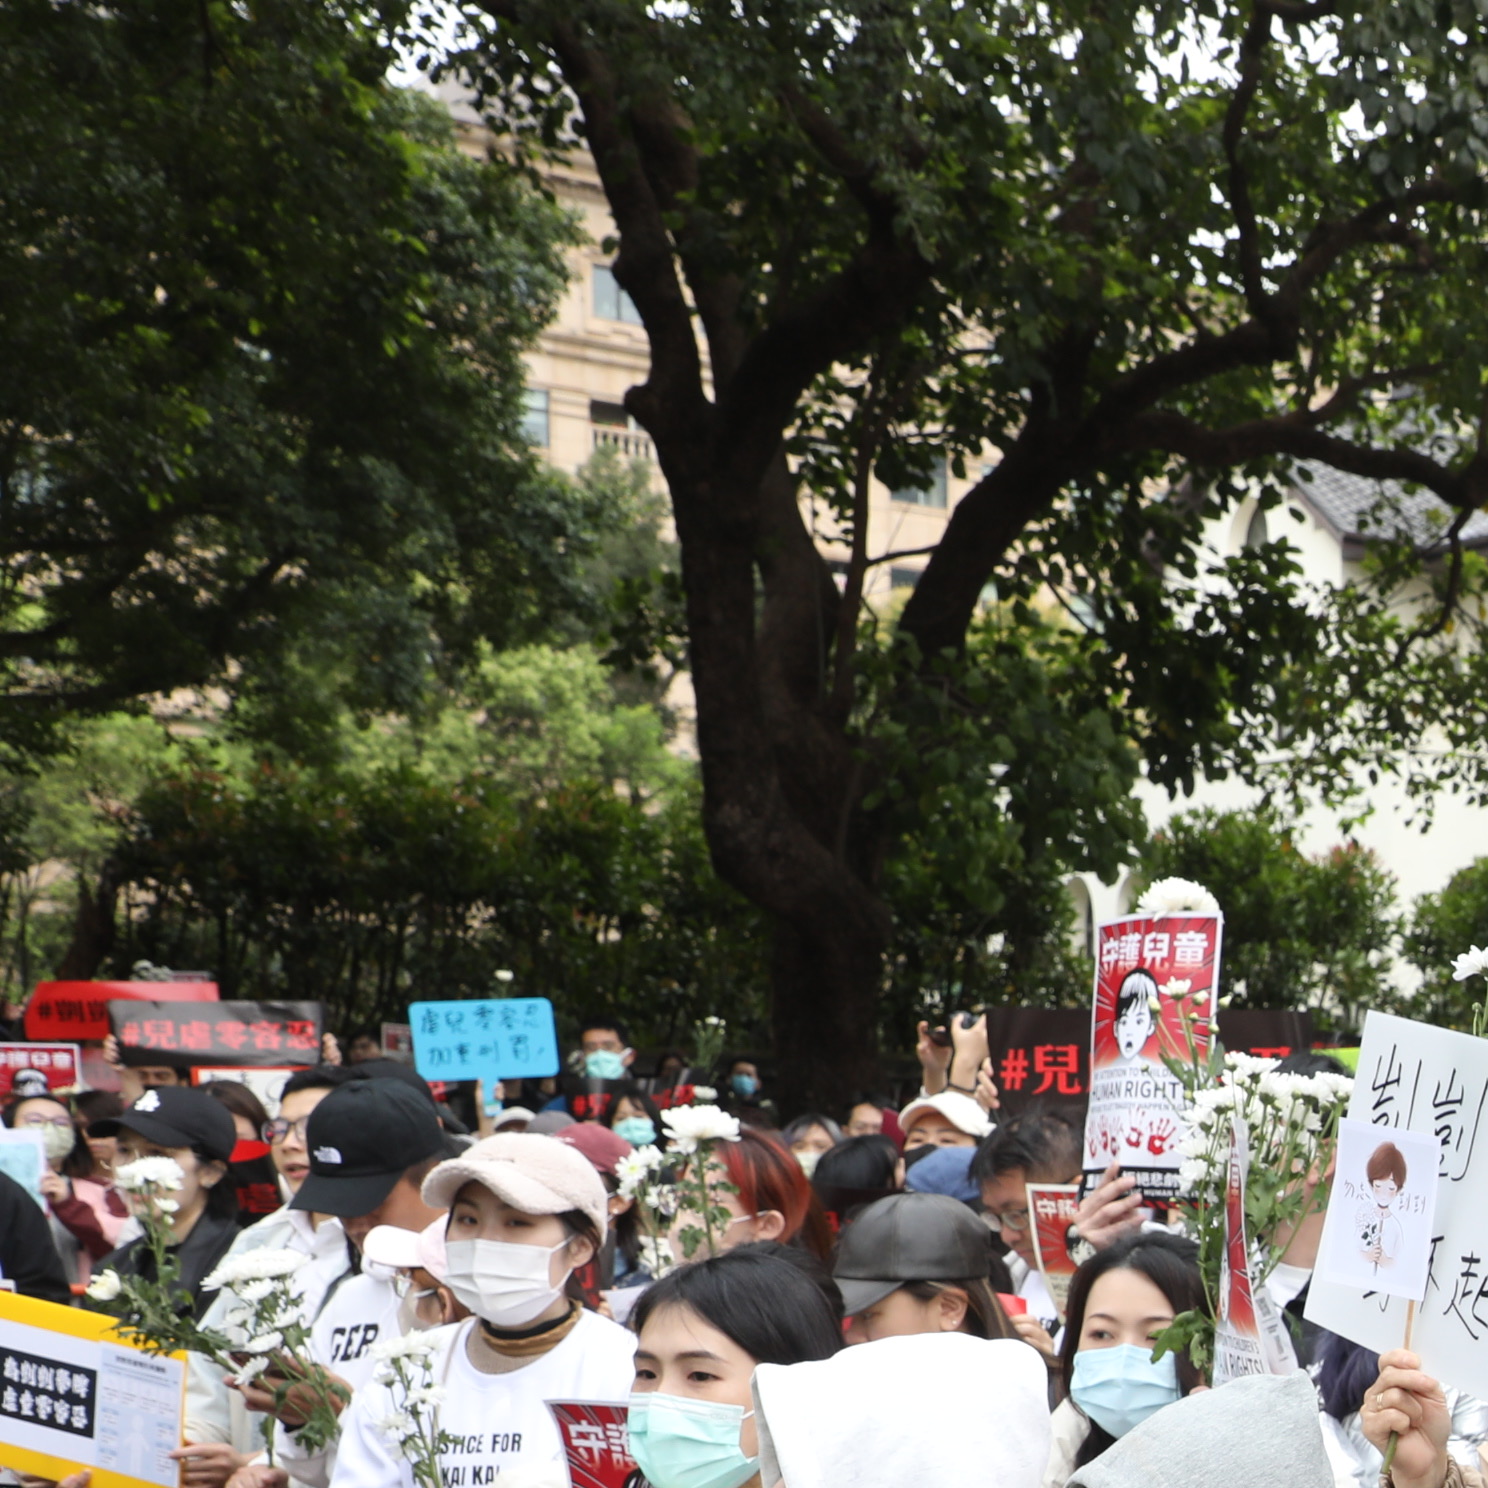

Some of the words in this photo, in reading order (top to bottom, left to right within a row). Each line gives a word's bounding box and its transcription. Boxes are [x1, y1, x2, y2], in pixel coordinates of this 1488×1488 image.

[1101, 930, 1209, 973] 守護兒童
[120, 1019, 319, 1050] #兒虐零容忍
[1124, 1081, 1187, 1100] RIGHT
[428, 1434, 484, 1454] STICE
[491, 1433, 522, 1453] FOR
